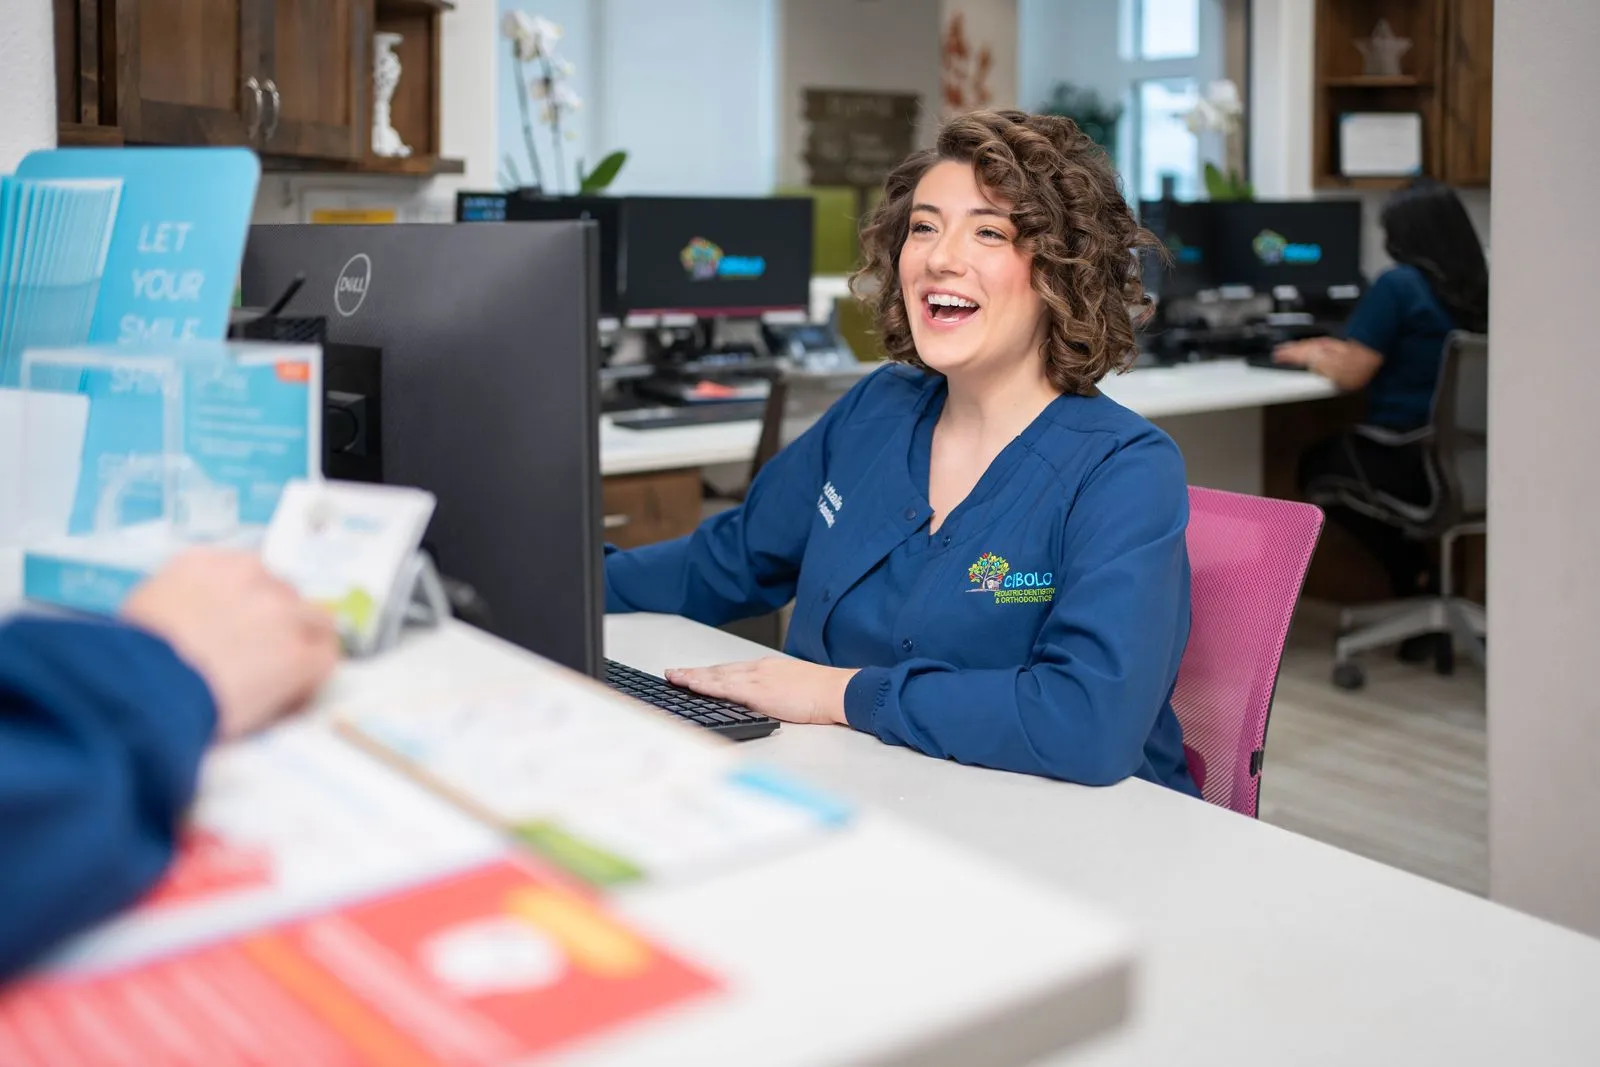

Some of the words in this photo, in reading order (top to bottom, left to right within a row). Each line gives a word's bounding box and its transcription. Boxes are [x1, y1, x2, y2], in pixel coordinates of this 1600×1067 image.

[137, 221, 192, 252] LET
[131, 269, 205, 301] YOUR
[339, 276, 364, 292] DELL
[1004, 571, 1053, 589] CIBOLO
[994, 588, 1023, 598] PEDIATRIC
[1024, 587, 1055, 597] DENTISTRY
[1001, 595, 1053, 604] ORTHODONTICS
